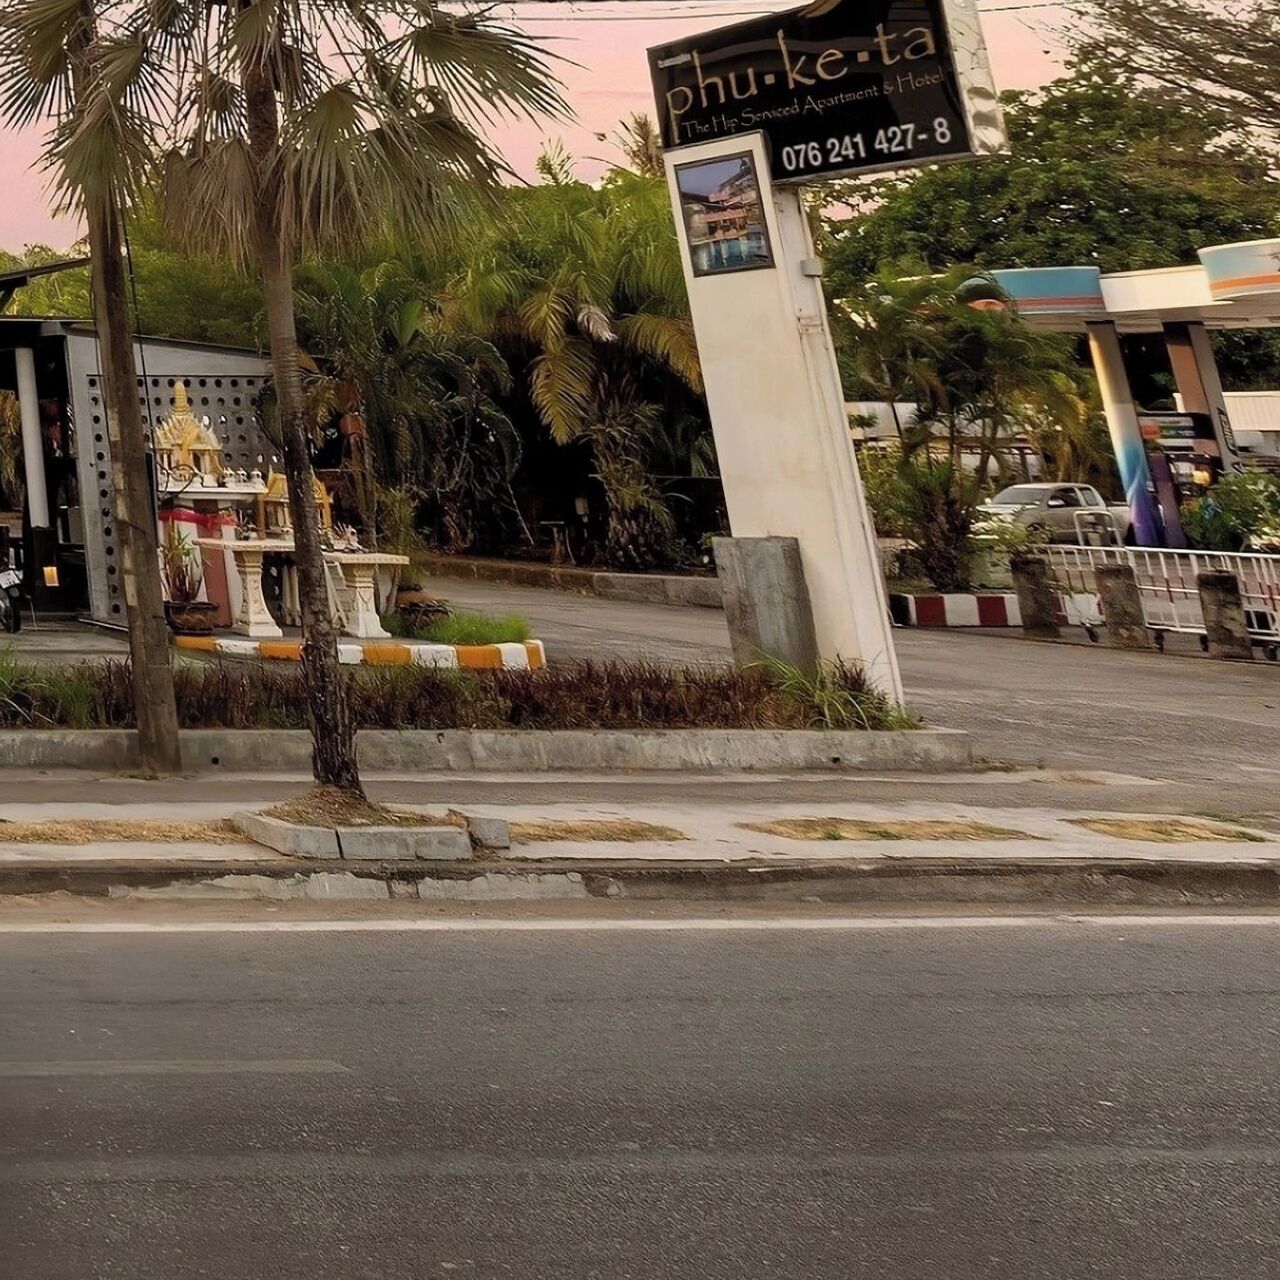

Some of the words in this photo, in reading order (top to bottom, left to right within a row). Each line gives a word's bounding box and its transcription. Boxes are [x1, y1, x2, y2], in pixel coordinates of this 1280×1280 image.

[681, 120, 710, 138] The
[711, 115, 739, 135] Hip
[741, 98, 800, 126] Serviced
[802, 86, 880, 116] Apartment
[882, 81, 894, 96] &
[896, 67, 946, 95] Hotel
[781, 142, 821, 171] 076
[828, 132, 867, 164] 241
